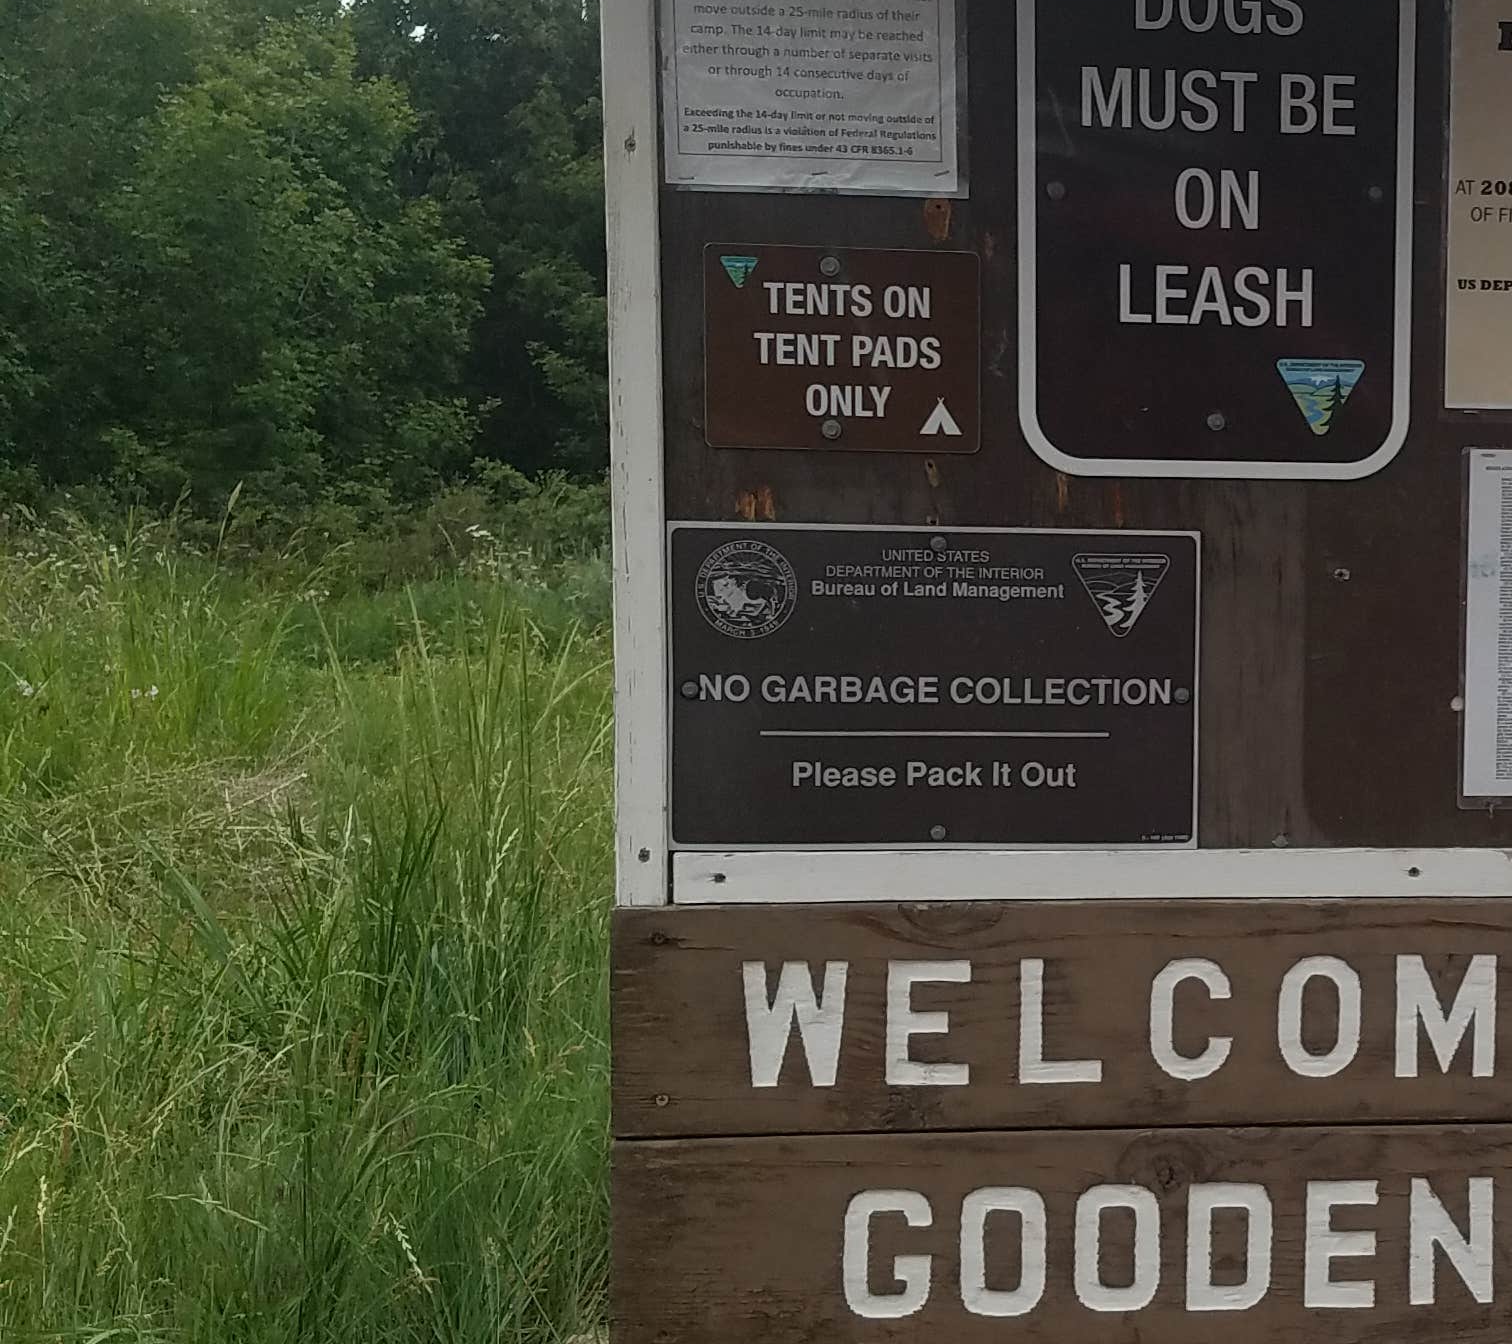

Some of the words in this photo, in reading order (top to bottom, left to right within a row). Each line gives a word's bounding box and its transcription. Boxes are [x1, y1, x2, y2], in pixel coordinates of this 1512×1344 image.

[1082, 67, 1257, 131] MUST
[1281, 74, 1355, 135] BE
[1176, 168, 1258, 229] ON
[1455, 179, 1476, 195] AT
[1470, 206, 1494, 222] OF
[1120, 264, 1312, 326] LEASH
[1457, 279, 1476, 290] US
[763, 282, 872, 317] TENTS
[884, 286, 930, 318] ON
[754, 332, 841, 366] TENT
[853, 335, 941, 369] PADS
[806, 384, 891, 417] ONLY
[882, 549, 933, 561] UNITED
[937, 550, 990, 563] STATES
[825, 565, 920, 578] DEPARTMENT
[923, 566, 942, 579] OF
[946, 567, 975, 579] THE
[979, 567, 1044, 580] INTERIOR
[811, 580, 875, 596] Bureau
[881, 581, 898, 596] of
[904, 581, 947, 596] Land
[953, 582, 1064, 601] Management
[700, 674, 750, 701] NO
[762, 675, 939, 703] GARBAGE
[950, 677, 1171, 705] COLLECTION
[793, 762, 896, 787] Please
[907, 762, 982, 786] Pack
[993, 762, 1011, 786] It
[1021, 762, 1076, 787] Out
